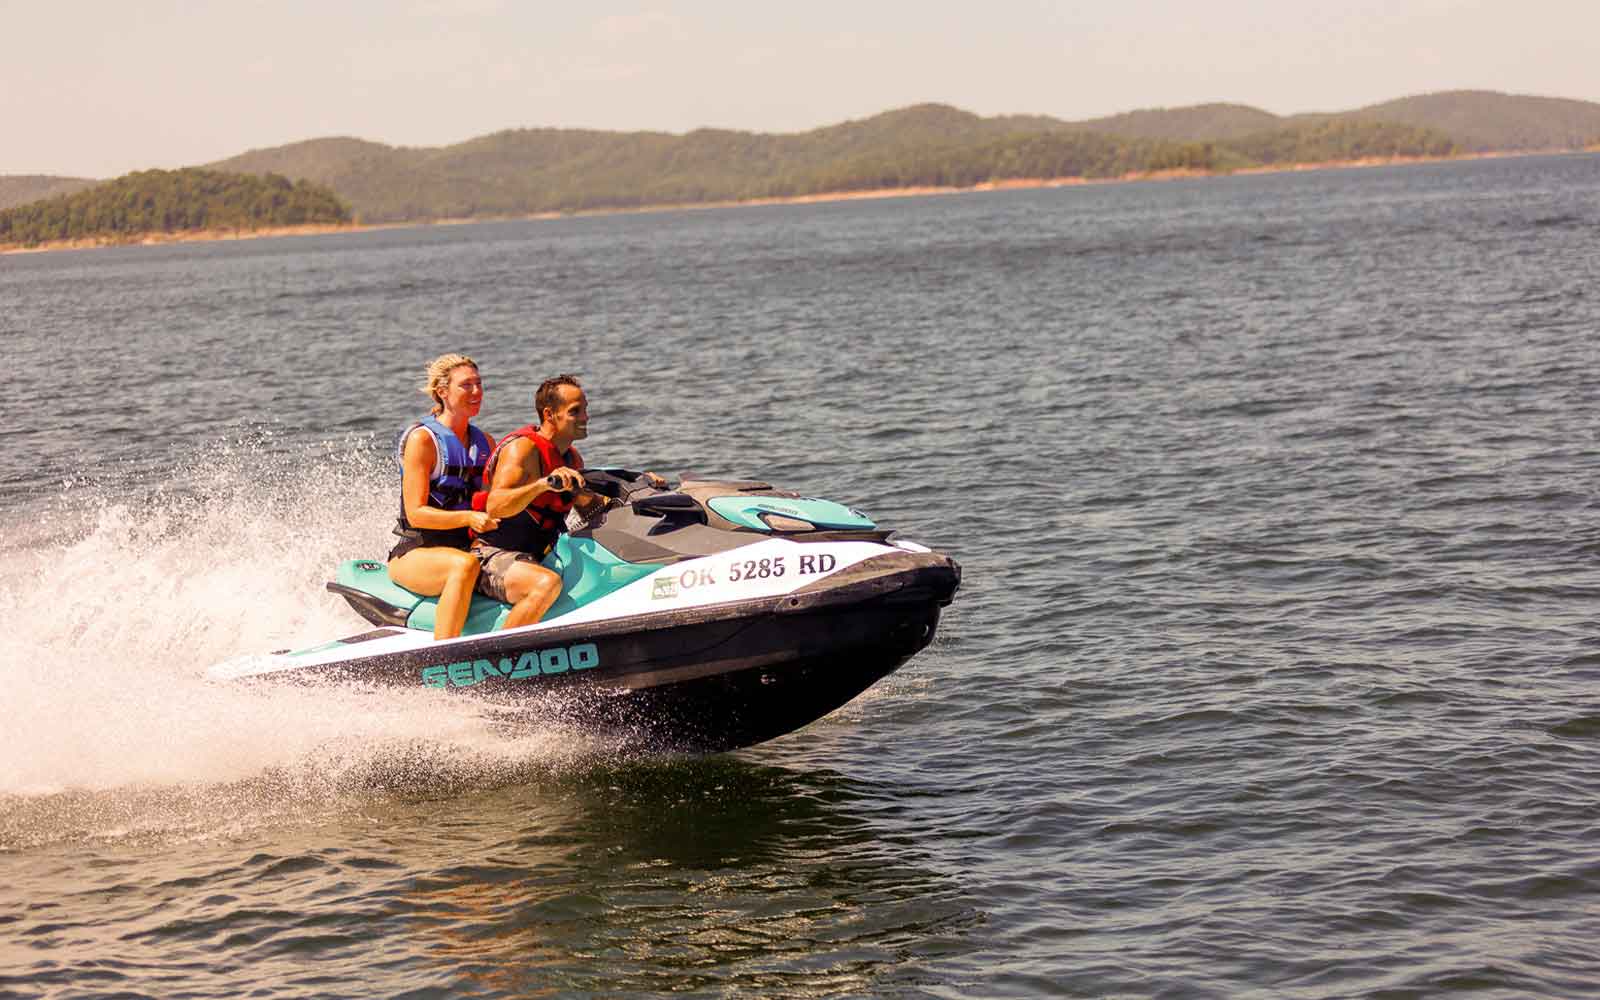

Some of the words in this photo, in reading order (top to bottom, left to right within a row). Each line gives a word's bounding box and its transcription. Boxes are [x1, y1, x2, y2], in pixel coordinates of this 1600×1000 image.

[680, 567, 716, 589] OK
[729, 557, 786, 582] 5285
[799, 554, 836, 574] RD
